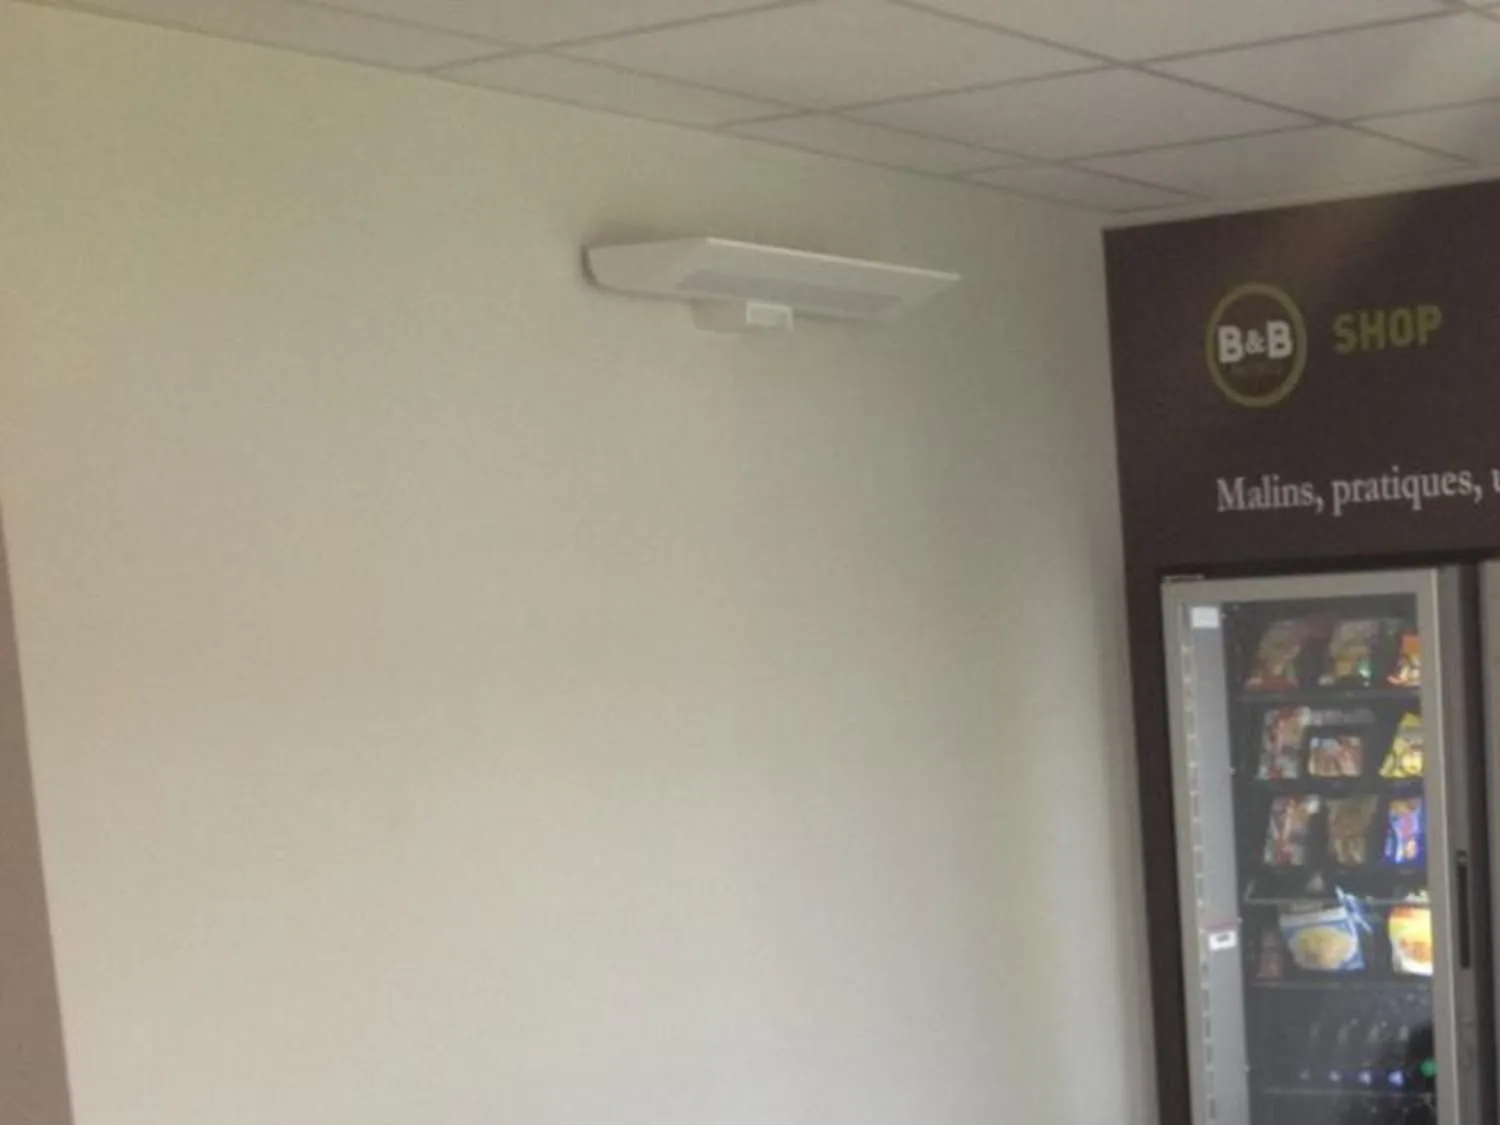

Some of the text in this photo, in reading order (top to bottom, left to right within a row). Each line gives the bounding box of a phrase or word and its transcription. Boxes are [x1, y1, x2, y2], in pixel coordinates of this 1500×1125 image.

[1332, 304, 1443, 355] SHOP
[1216, 474, 1325, 513] Malins,
[1330, 465, 1483, 516] pratiques,
